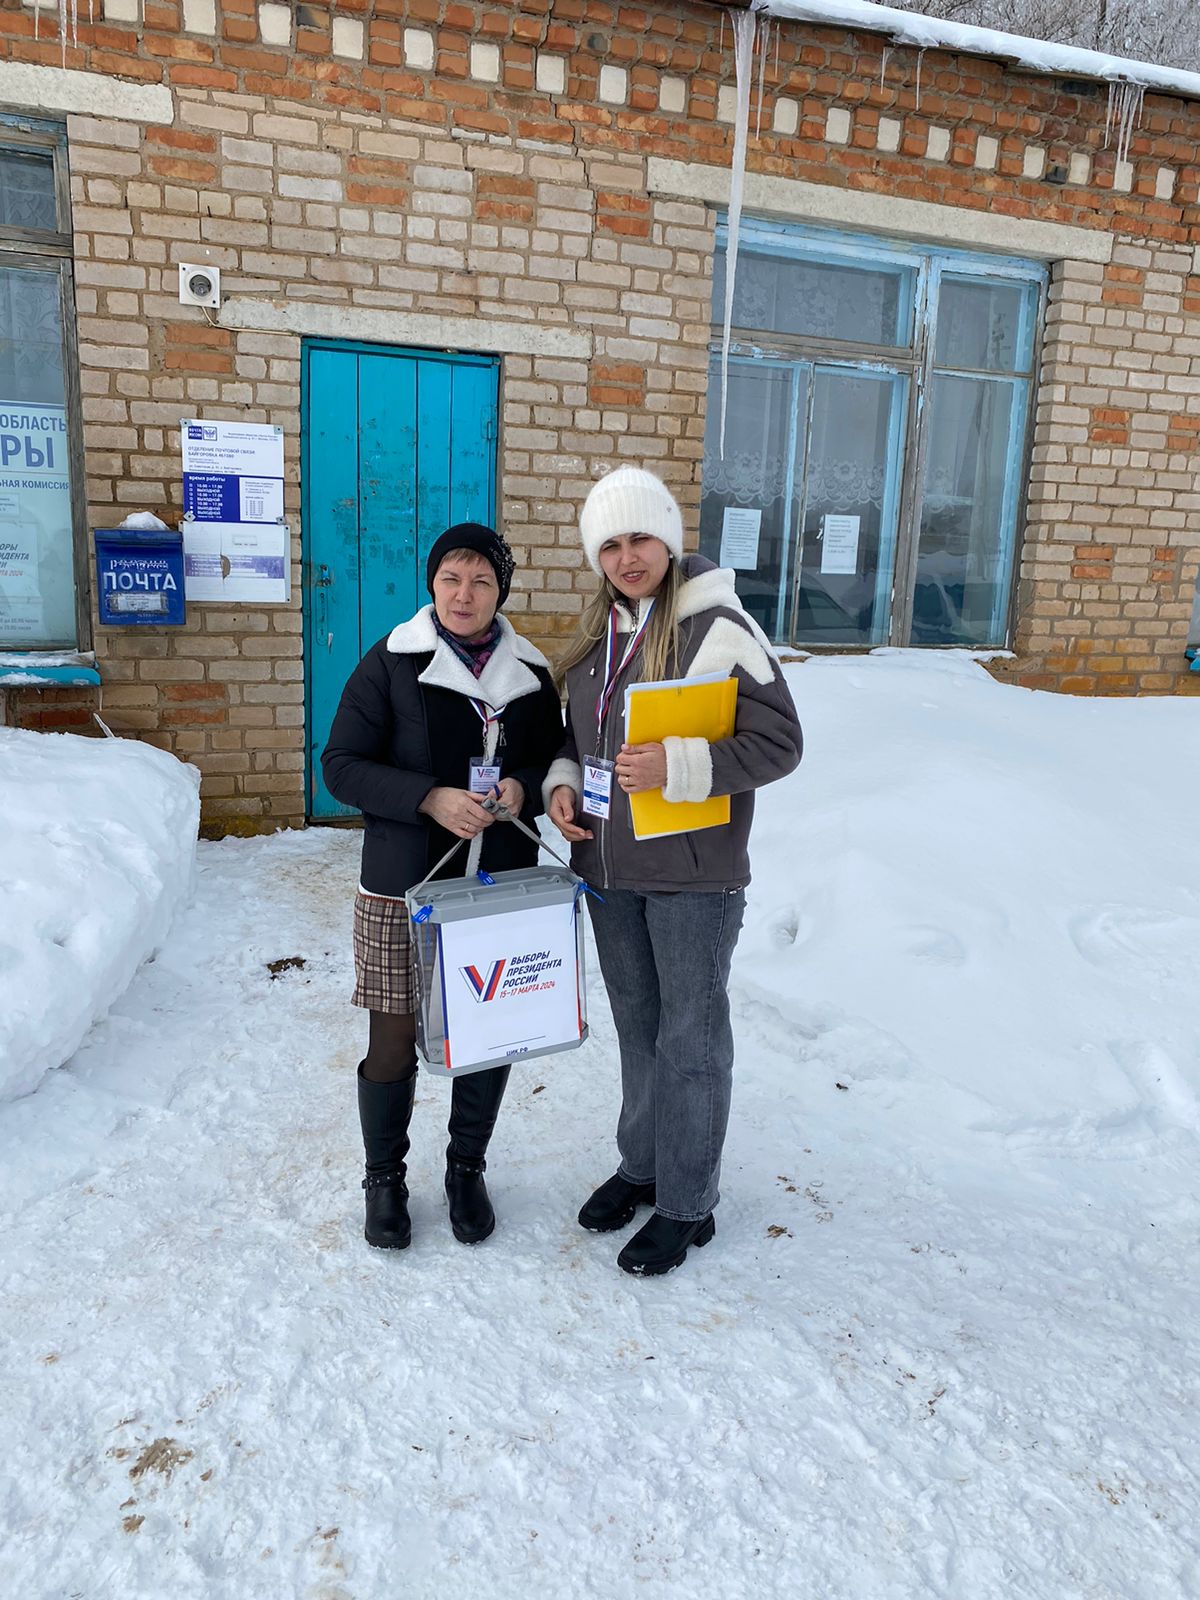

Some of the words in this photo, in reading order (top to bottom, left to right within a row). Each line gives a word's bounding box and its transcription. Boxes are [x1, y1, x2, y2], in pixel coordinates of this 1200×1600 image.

[0, 414, 66, 432] ОБЛАСТЬ
[103, 572, 177, 590] ПОЧТА
[510, 950, 551, 966] ВЫБОРЫ
[506, 958, 562, 978] ПРЕЗИДЕНТА
[502, 973, 539, 989] РОССИИ
[517, 983, 540, 995] МАРТА
[540, 980, 556, 991] 2024
